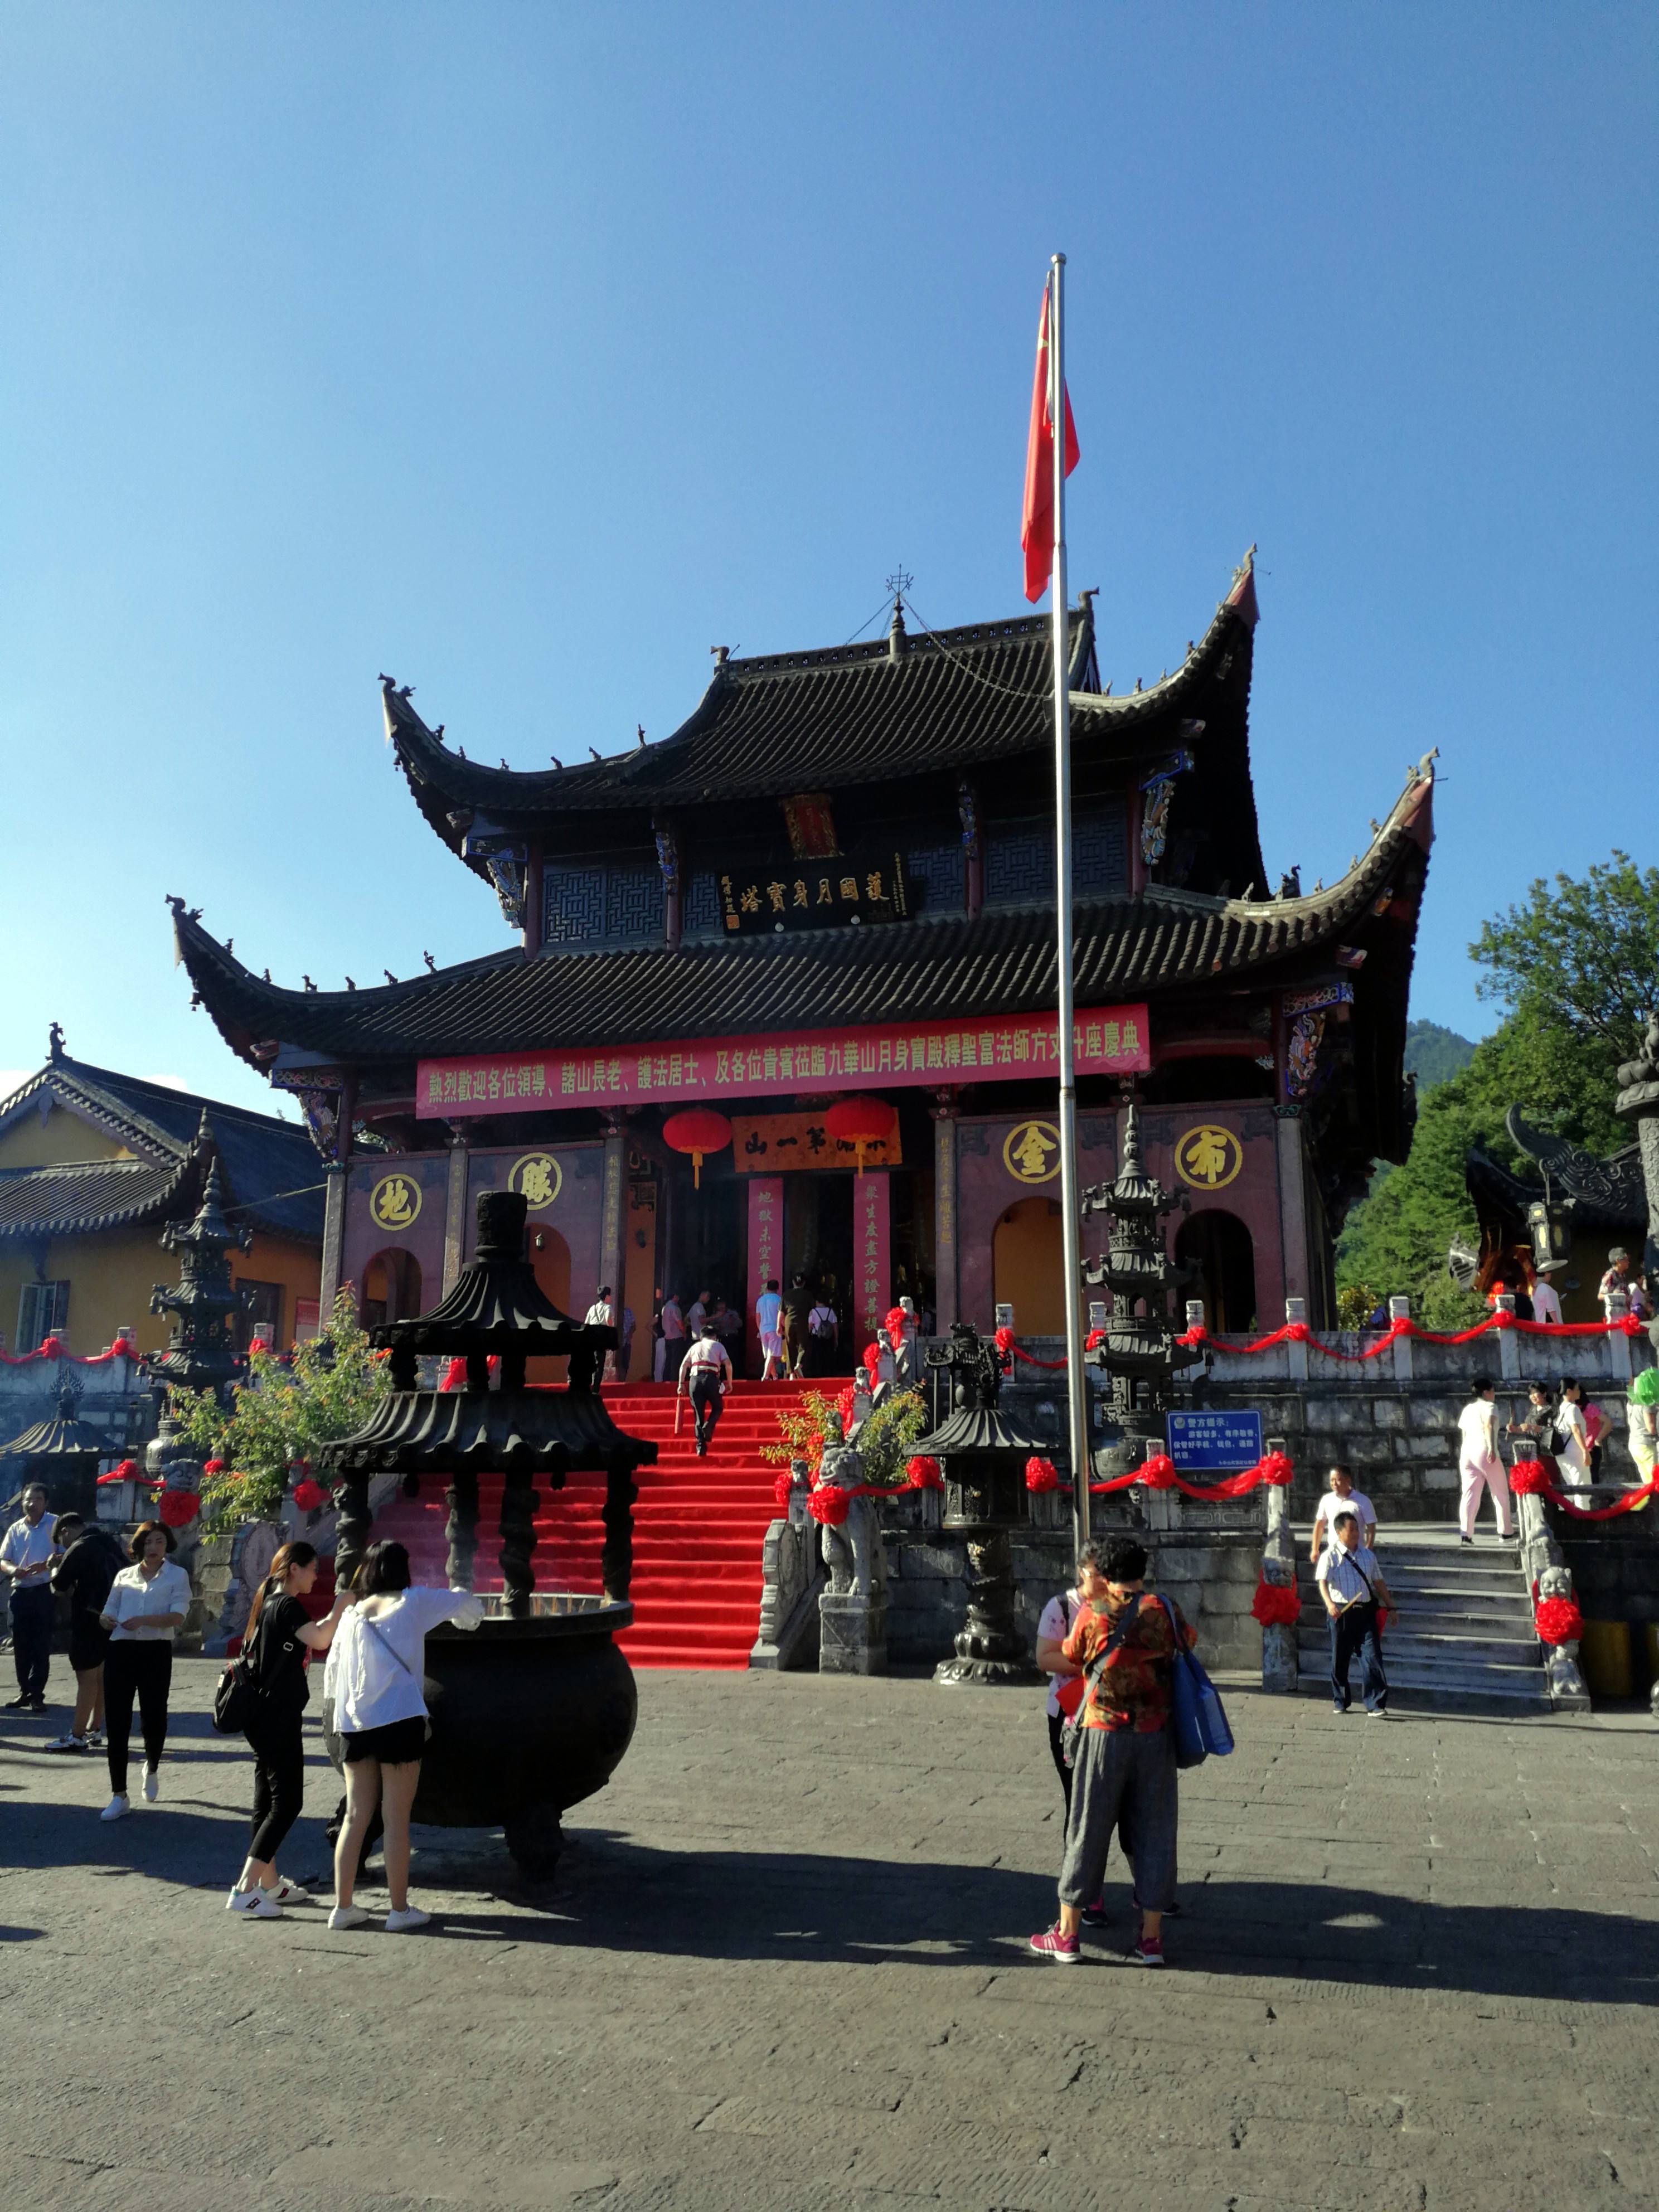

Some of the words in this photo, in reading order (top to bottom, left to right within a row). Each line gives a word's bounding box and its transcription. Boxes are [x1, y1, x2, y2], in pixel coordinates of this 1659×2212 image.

[1012, 1126, 1056, 1175] 金
[1186, 1131, 1227, 1183] 布
[379, 1179, 411, 1221] 地
